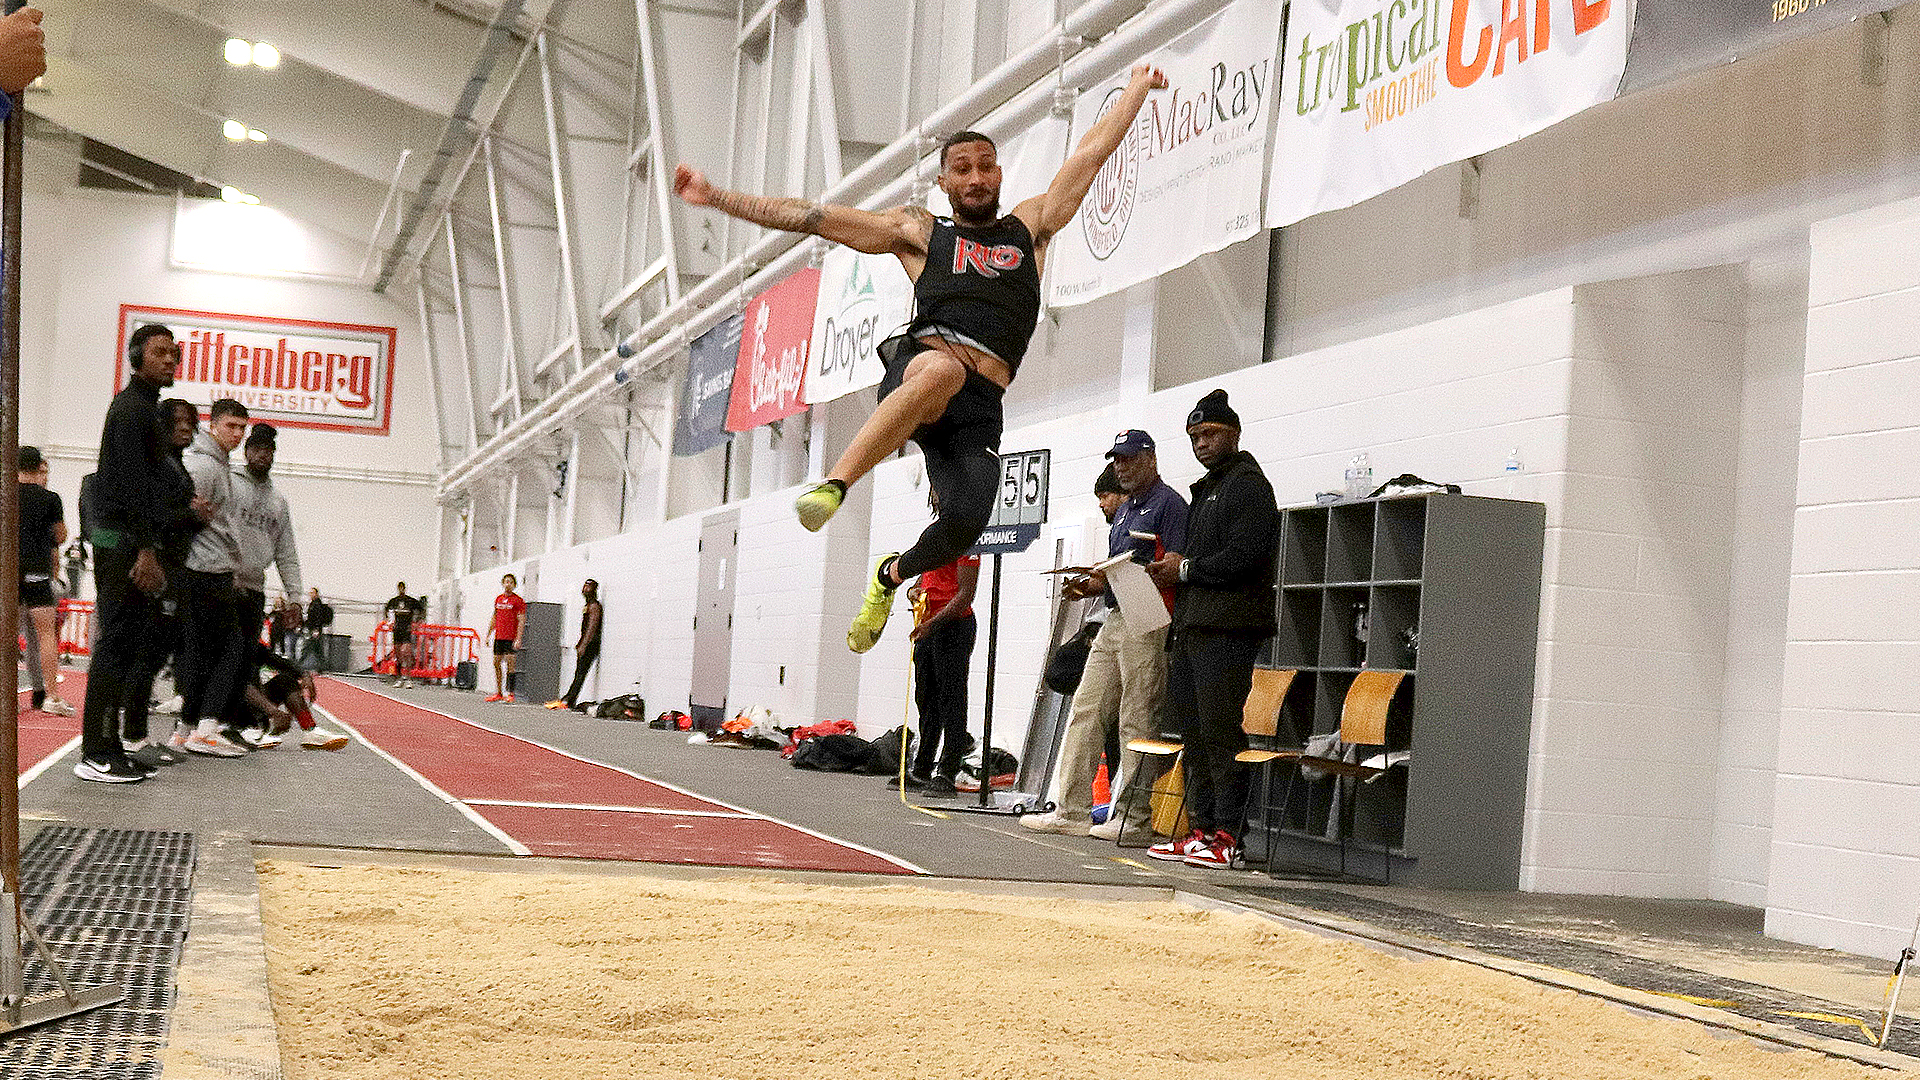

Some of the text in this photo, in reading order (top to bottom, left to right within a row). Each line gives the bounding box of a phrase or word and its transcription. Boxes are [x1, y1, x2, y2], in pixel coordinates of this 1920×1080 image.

[1296, 0, 1441, 116] tropical
[1446, 0, 1612, 89] CA
[1147, 58, 1269, 161] MacRay
[1364, 56, 1440, 133] SMOOTHIE
[952, 236, 1025, 279] RIO
[209, 389, 333, 415] UNIVERSITY
